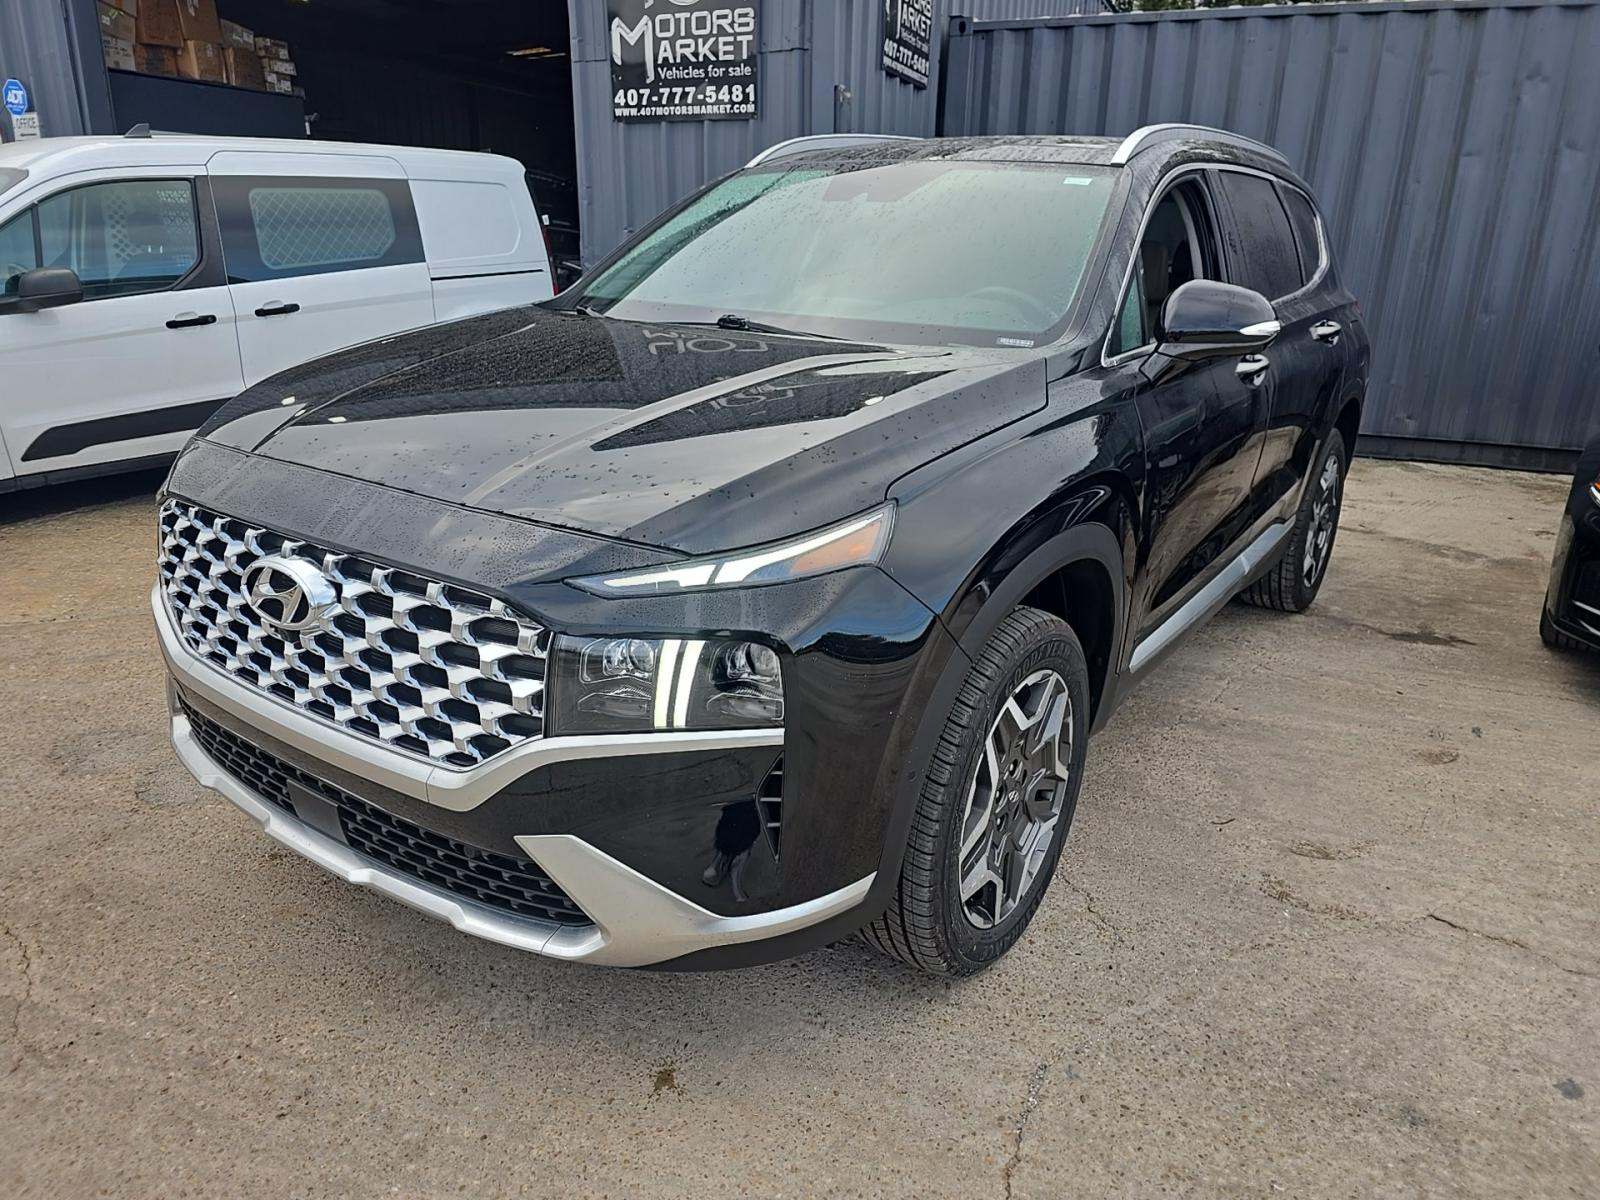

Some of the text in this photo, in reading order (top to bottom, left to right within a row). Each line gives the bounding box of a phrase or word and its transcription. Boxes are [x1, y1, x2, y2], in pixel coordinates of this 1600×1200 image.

[657, 63, 752, 80] Vehicles for sale
[614, 84, 755, 106] 407-777-5481
